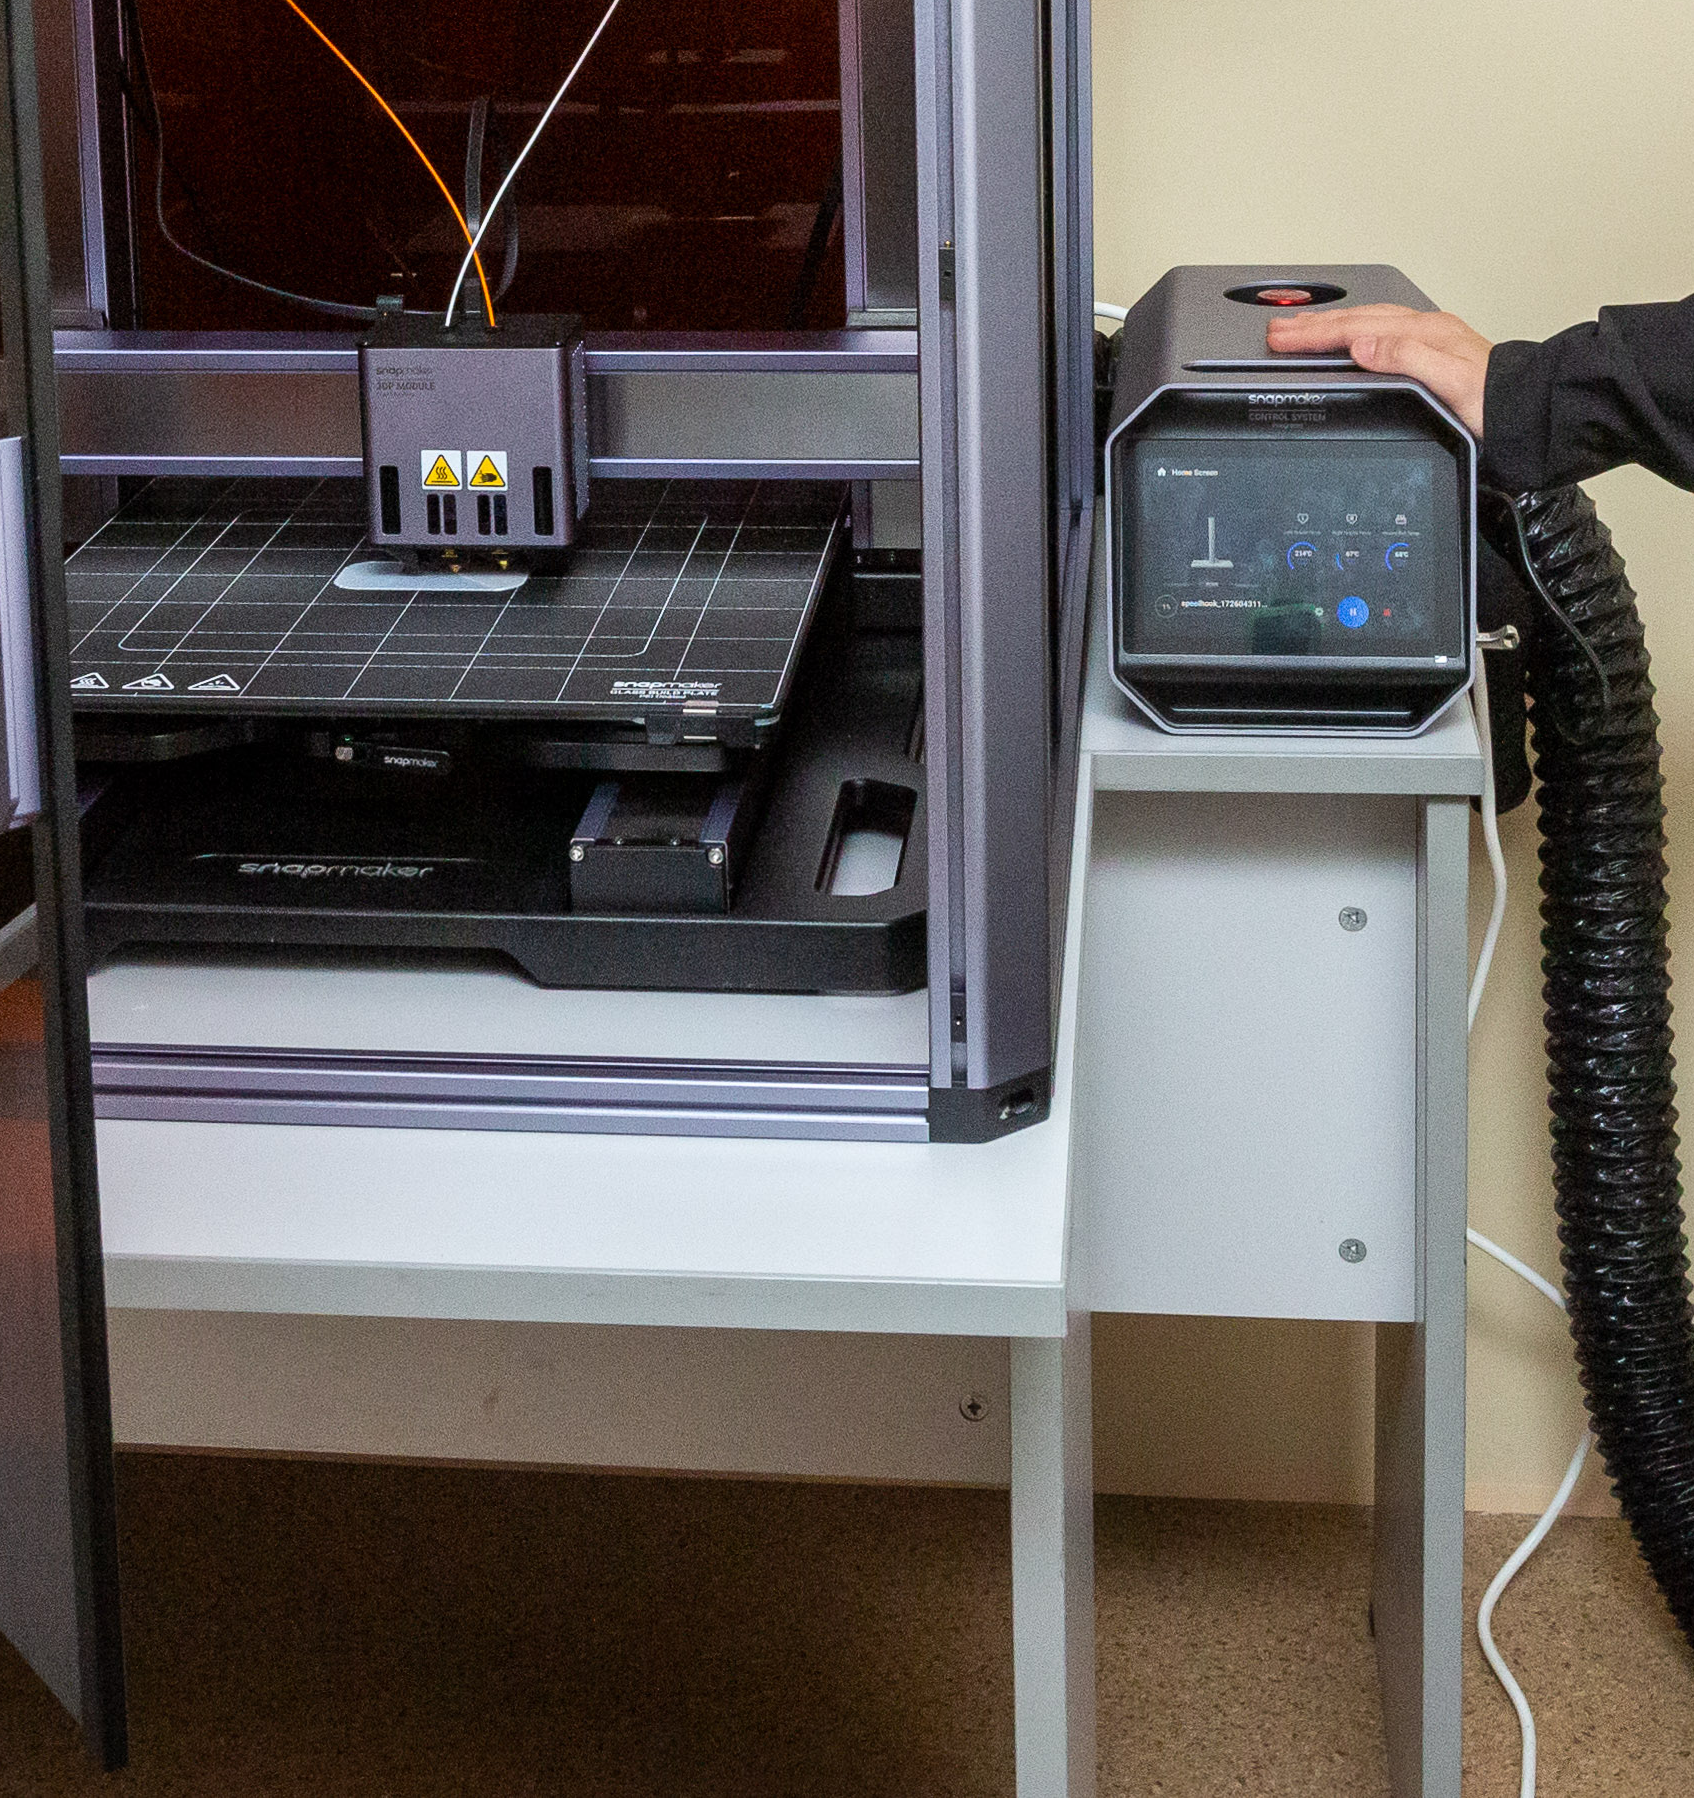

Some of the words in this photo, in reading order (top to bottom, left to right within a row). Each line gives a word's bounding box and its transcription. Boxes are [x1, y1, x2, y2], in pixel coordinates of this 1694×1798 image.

[1248, 393, 1326, 407] snapmaker
[1249, 412, 1289, 421] CONTROL
[1291, 412, 1326, 421] SYSTEM
[1194, 468, 1219, 476] Screen
[613, 680, 722, 691] snapmaker
[685, 689, 719, 697] PLATE
[384, 755, 439, 768] snapmaker
[238, 862, 433, 879] snapmaker
